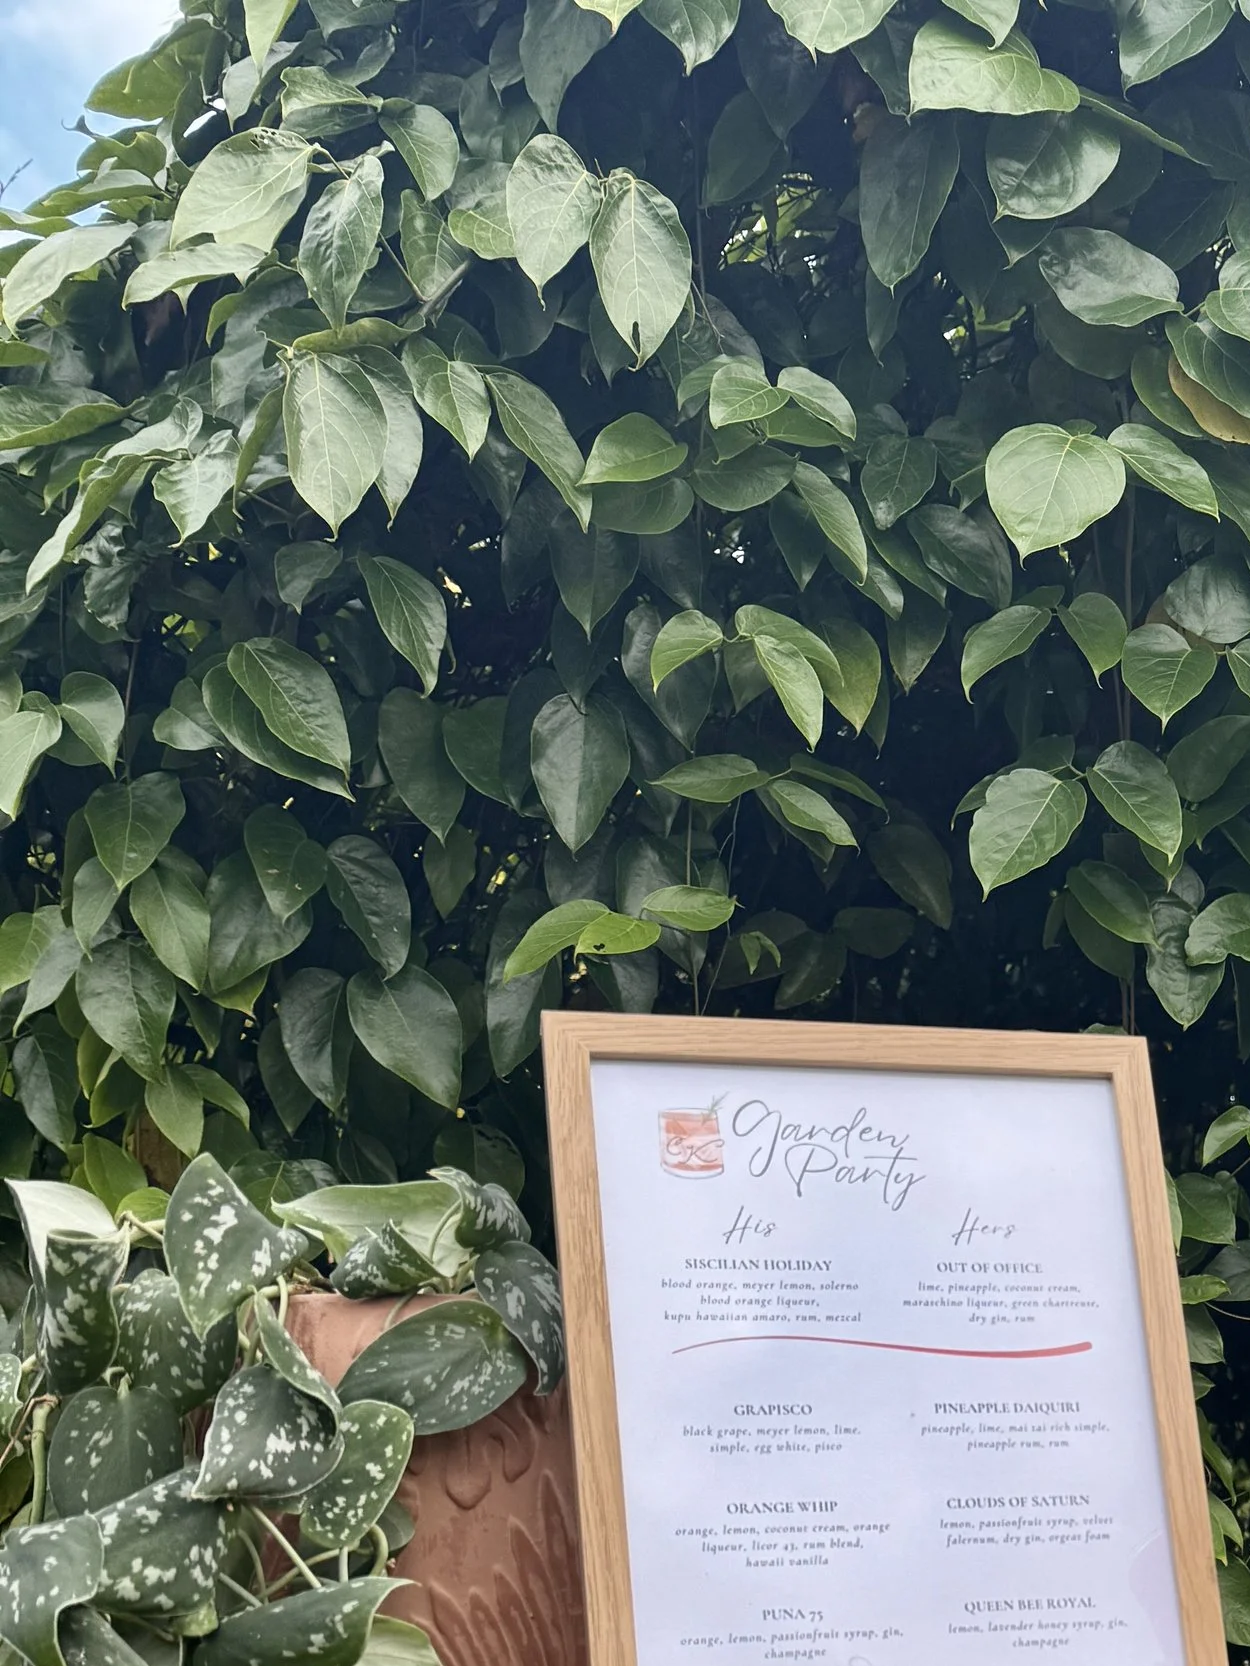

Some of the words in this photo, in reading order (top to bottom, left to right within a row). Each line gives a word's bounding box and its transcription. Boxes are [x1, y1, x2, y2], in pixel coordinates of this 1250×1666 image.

[732, 1100, 910, 1177] Garden
[785, 1143, 926, 1211] Party
[722, 1206, 778, 1244] His
[952, 1208, 1016, 1246] Hers
[685, 1258, 760, 1270] SISCILIAN
[764, 1260, 832, 1272] HOLIDAY
[937, 1262, 967, 1273] OUT
[971, 1262, 990, 1273] OF
[994, 1263, 1043, 1274] OFFICE
[661, 1279, 692, 1289] blood
[696, 1282, 737, 1292] orange,
[743, 1282, 775, 1292] meyer
[779, 1280, 815, 1291] lemon,
[820, 1281, 858, 1290] solerno
[918, 1281, 944, 1292] lime,
[948, 1282, 1000, 1295] pineapple,
[1048, 1285, 1081, 1294] cream,
[700, 1295, 730, 1305] blood
[735, 1298, 772, 1308] orange
[777, 1296, 820, 1308] liqueur,
[903, 1297, 963, 1307] maraschino
[967, 1297, 1007, 1310] liqueur,
[1011, 1300, 1039, 1310] green
[1043, 1298, 1100, 1308] chartreuse,
[664, 1311, 691, 1323] kupu
[696, 1311, 747, 1321] hawaiian
[752, 1313, 791, 1323] amaro,
[795, 1313, 821, 1323] rum,
[826, 1312, 861, 1322] mezcal
[969, 1313, 987, 1326] dry
[991, 1313, 1010, 1325] gin,
[734, 1404, 813, 1416] GRAPISCO
[934, 1402, 1010, 1414] PINEAPPLE
[1014, 1402, 1080, 1416] DAIQUIRI
[683, 1425, 713, 1436] black
[717, 1427, 751, 1438] grape,
[757, 1427, 790, 1438] meyer
[794, 1425, 830, 1436] lemon,
[834, 1425, 861, 1435] lime,
[921, 1423, 974, 1436] pineapple,
[979, 1423, 1005, 1434] lime,
[1009, 1423, 1028, 1433] mai
[1032, 1423, 1046, 1432] tai
[1050, 1422, 1070, 1432] rich
[1074, 1422, 1110, 1434] simple,
[710, 1442, 750, 1455] simple,
[754, 1444, 772, 1454] egg
[777, 1442, 810, 1453] white,
[815, 1442, 842, 1453] pisco
[968, 1438, 1016, 1451] pineapple
[1020, 1441, 1044, 1449] rum,
[727, 1502, 794, 1514] ORANGE
[797, 1501, 838, 1513] WHIP
[946, 1497, 1005, 1509] CLOUDS
[1009, 1497, 1028, 1508] OF
[1031, 1495, 1090, 1507] SATURN
[940, 1519, 975, 1529] lemon,
[979, 1517, 1042, 1530] passionfruit
[1046, 1517, 1078, 1529] syrup,
[1083, 1515, 1113, 1526] velvet
[675, 1527, 717, 1539] orange,
[723, 1524, 760, 1535] lemon,
[765, 1525, 808, 1534] coconut
[813, 1524, 849, 1533] cream,
[853, 1523, 891, 1534] orange
[702, 1542, 746, 1555] liqueur,
[752, 1541, 778, 1551] licor
[804, 1541, 826, 1549] rum
[830, 1537, 864, 1549] blend,
[946, 1534, 998, 1548] falernum,
[1003, 1532, 1021, 1545] dry
[1025, 1532, 1045, 1545] gin,
[1049, 1532, 1081, 1544] orgeat
[1085, 1530, 1110, 1543] foam
[746, 1556, 784, 1568] hawaii
[789, 1555, 829, 1566] vanilla
[964, 1600, 1014, 1614] QUEEN
[1018, 1599, 1043, 1610] BEE
[1047, 1597, 1096, 1609] ROYAL
[762, 1609, 805, 1621] PUNA
[809, 1610, 824, 1622] 75
[949, 1623, 984, 1634] lemon,
[988, 1621, 1034, 1632] lavender
[1038, 1619, 1068, 1631] honey
[1072, 1619, 1103, 1631] syrup,
[1108, 1618, 1128, 1630] gin,
[680, 1636, 723, 1648] orange,
[728, 1633, 766, 1644] lemon,
[771, 1628, 839, 1642] passionfruit
[844, 1629, 878, 1641] syrup,
[883, 1627, 904, 1639] gin,
[1012, 1638, 1070, 1649] champagne
[764, 1648, 827, 1660] champagne
